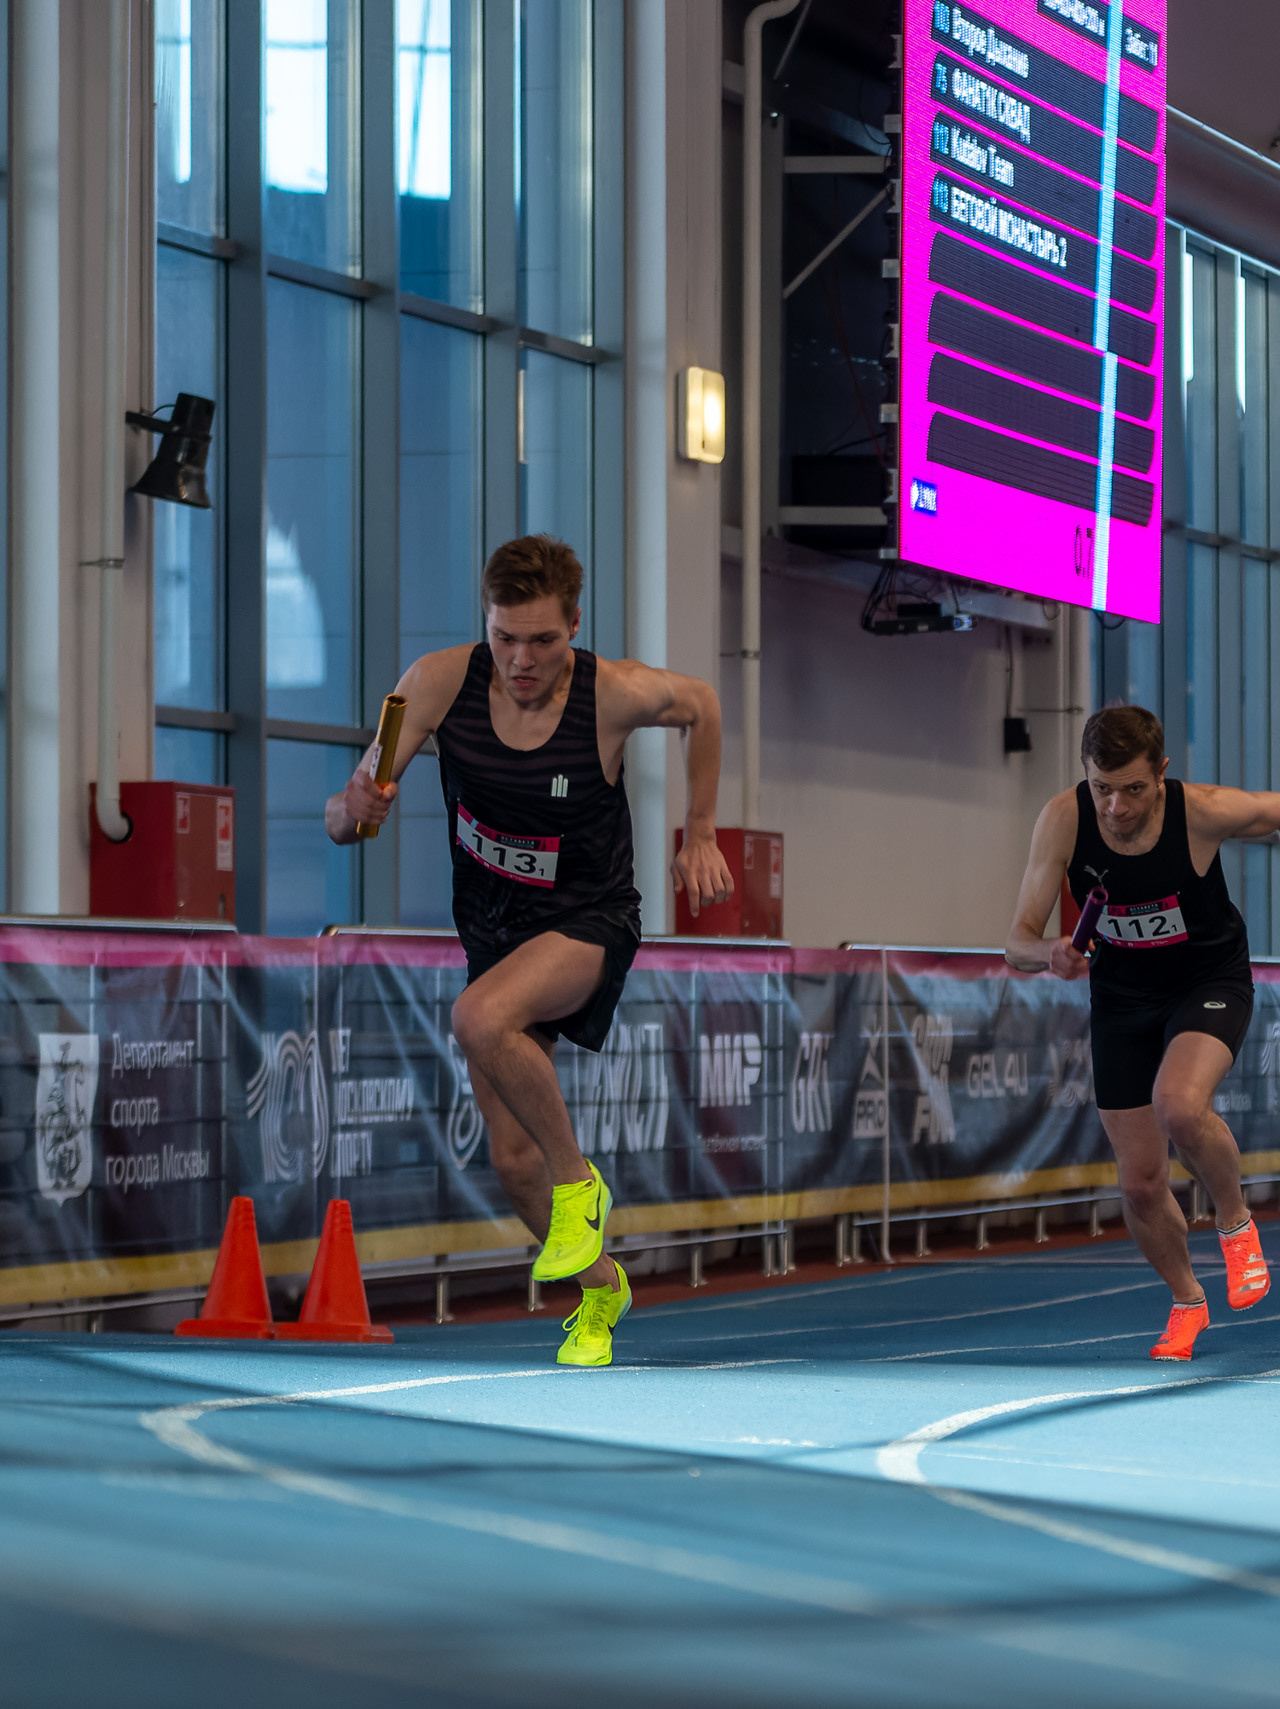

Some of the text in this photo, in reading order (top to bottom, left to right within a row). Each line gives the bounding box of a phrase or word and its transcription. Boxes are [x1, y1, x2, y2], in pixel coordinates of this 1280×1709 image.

[472, 833, 545, 877] 113 1
[1107, 915, 1178, 939] 112 1
[112, 1033, 195, 1078] Департамент
[111, 1097, 160, 1136] спорта
[105, 1145, 210, 1194] города Москвы
